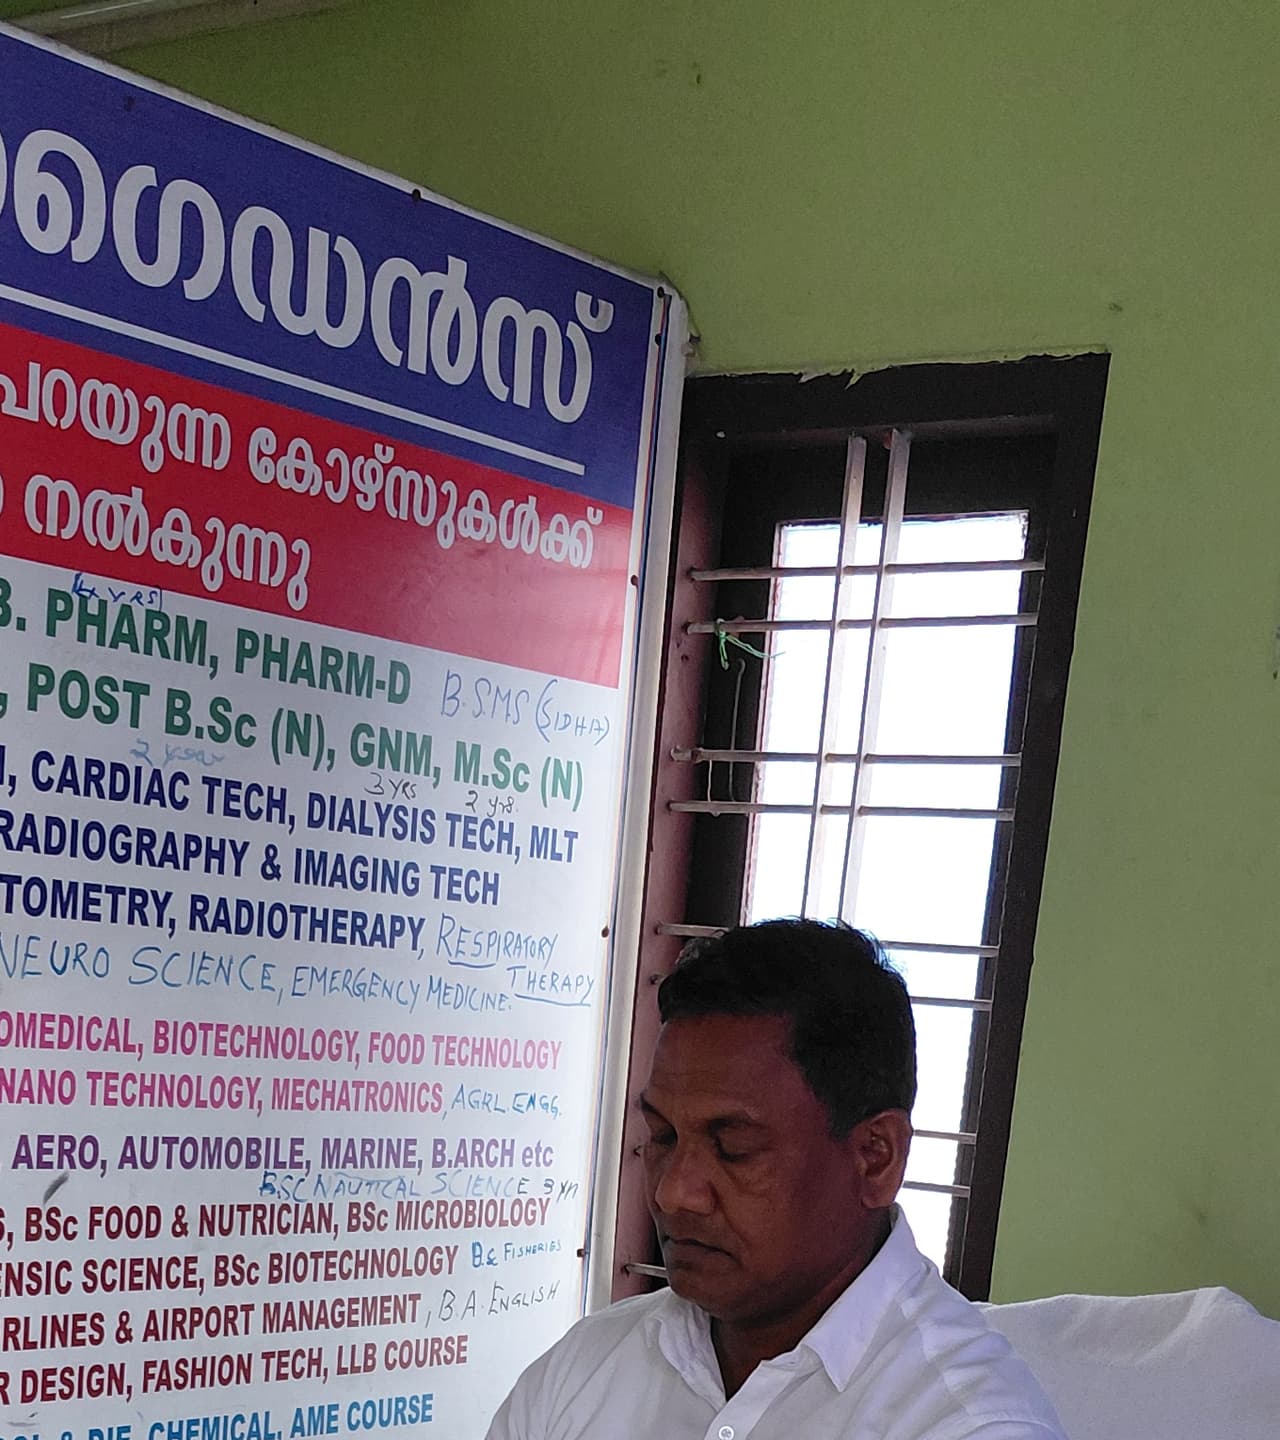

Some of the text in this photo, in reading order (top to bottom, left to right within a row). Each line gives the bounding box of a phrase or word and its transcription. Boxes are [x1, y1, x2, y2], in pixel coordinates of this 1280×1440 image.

[247, 433, 604, 571] കോഴ്സുകൾക്ക്
[25, 474, 313, 612] നൽകുന്നു
[44, 586, 219, 679] PHARM,
[233, 626, 411, 705] PHARM-D
[25, 660, 151, 730] POST
[163, 686, 257, 749] B.Sc
[270, 706, 336, 771] (N),
[349, 721, 441, 785] GNM,
[452, 739, 530, 792] M.Sc
[539, 755, 583, 808] (N)
[30, 749, 191, 812] CARDIAC
[200, 774, 296, 835] TECH,
[305, 790, 436, 845] DIALYSIS
[444, 810, 521, 863] TECH,
[528, 823, 579, 863] MLT
[259, 842, 283, 883] &
[292, 846, 421, 897] IMAGING
[428, 863, 500, 906] TECH
[187, 892, 426, 958] RADIOTHERAPY,
[434, 910, 559, 968] RESPIRATORY
[126, 941, 282, 1006] SCIENCE,
[289, 964, 421, 1015] EMERGENCY
[504, 963, 595, 1002] THERAPY
[85, 1069, 263, 1118] TECHNOLOGY,
[270, 1076, 443, 1113] MECHATRONICS
[9, 1133, 108, 1179] AERO,
[115, 1134, 312, 1178] AUTOMOBILE,
[319, 1136, 423, 1177] MARINE,
[430, 1137, 515, 1171] B.ARCH
[521, 1139, 554, 1167] etc
[429, 1168, 530, 1200] SCIENCE
[80, 1254, 205, 1297] SCIENCE,
[212, 1252, 261, 1288] BSc
[266, 1243, 459, 1285] BIOTECHNOLOGY
[486, 1278, 561, 1316] ENGLISH
[19, 1361, 133, 1414] DESIGN,
[140, 1351, 253, 1394] FASHION
[259, 1345, 329, 1385] TECH,
[334, 1341, 377, 1376] LLB
[383, 1334, 468, 1371] COURSE
